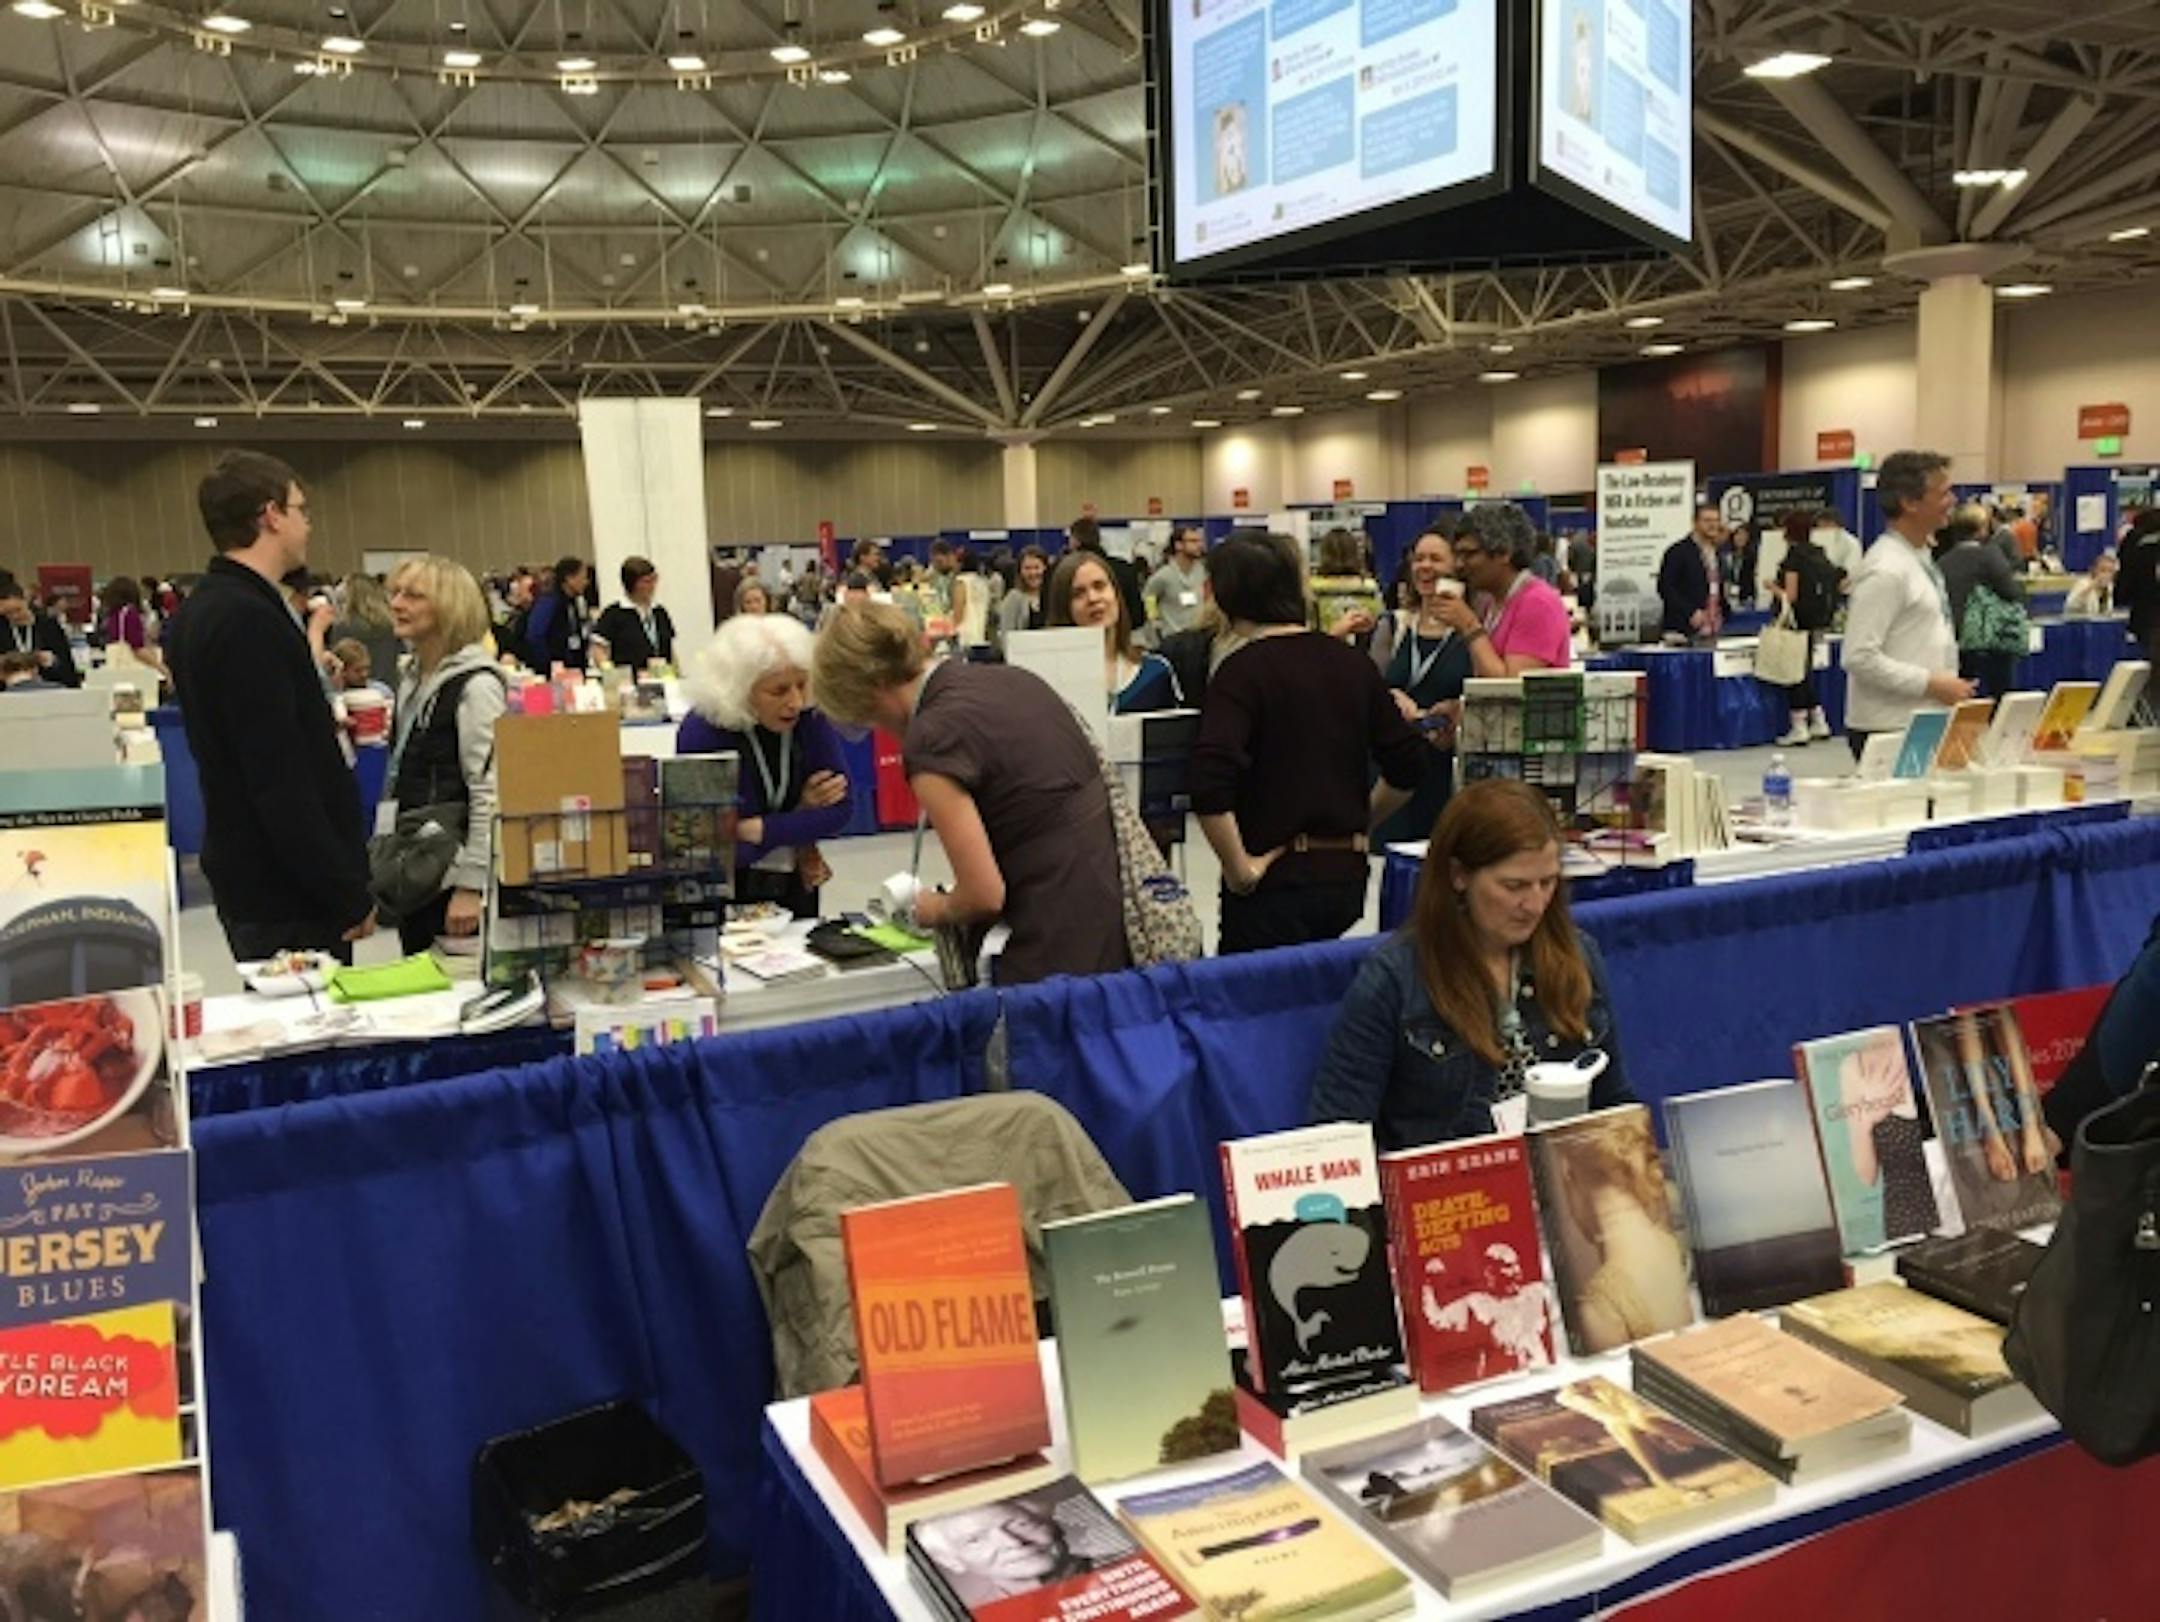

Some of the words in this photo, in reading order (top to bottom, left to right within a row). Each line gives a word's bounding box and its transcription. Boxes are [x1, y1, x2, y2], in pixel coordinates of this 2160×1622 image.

[1254, 1164, 1318, 1193] WHALE
[1320, 1158, 1363, 1182] MAN
[51, 1203, 94, 1221] FAT
[17, 1274, 127, 1308] BLUES
[869, 1300, 927, 1354] OLD
[932, 1293, 1032, 1350] FLAME
[49, 1352, 129, 1374] BLACK
